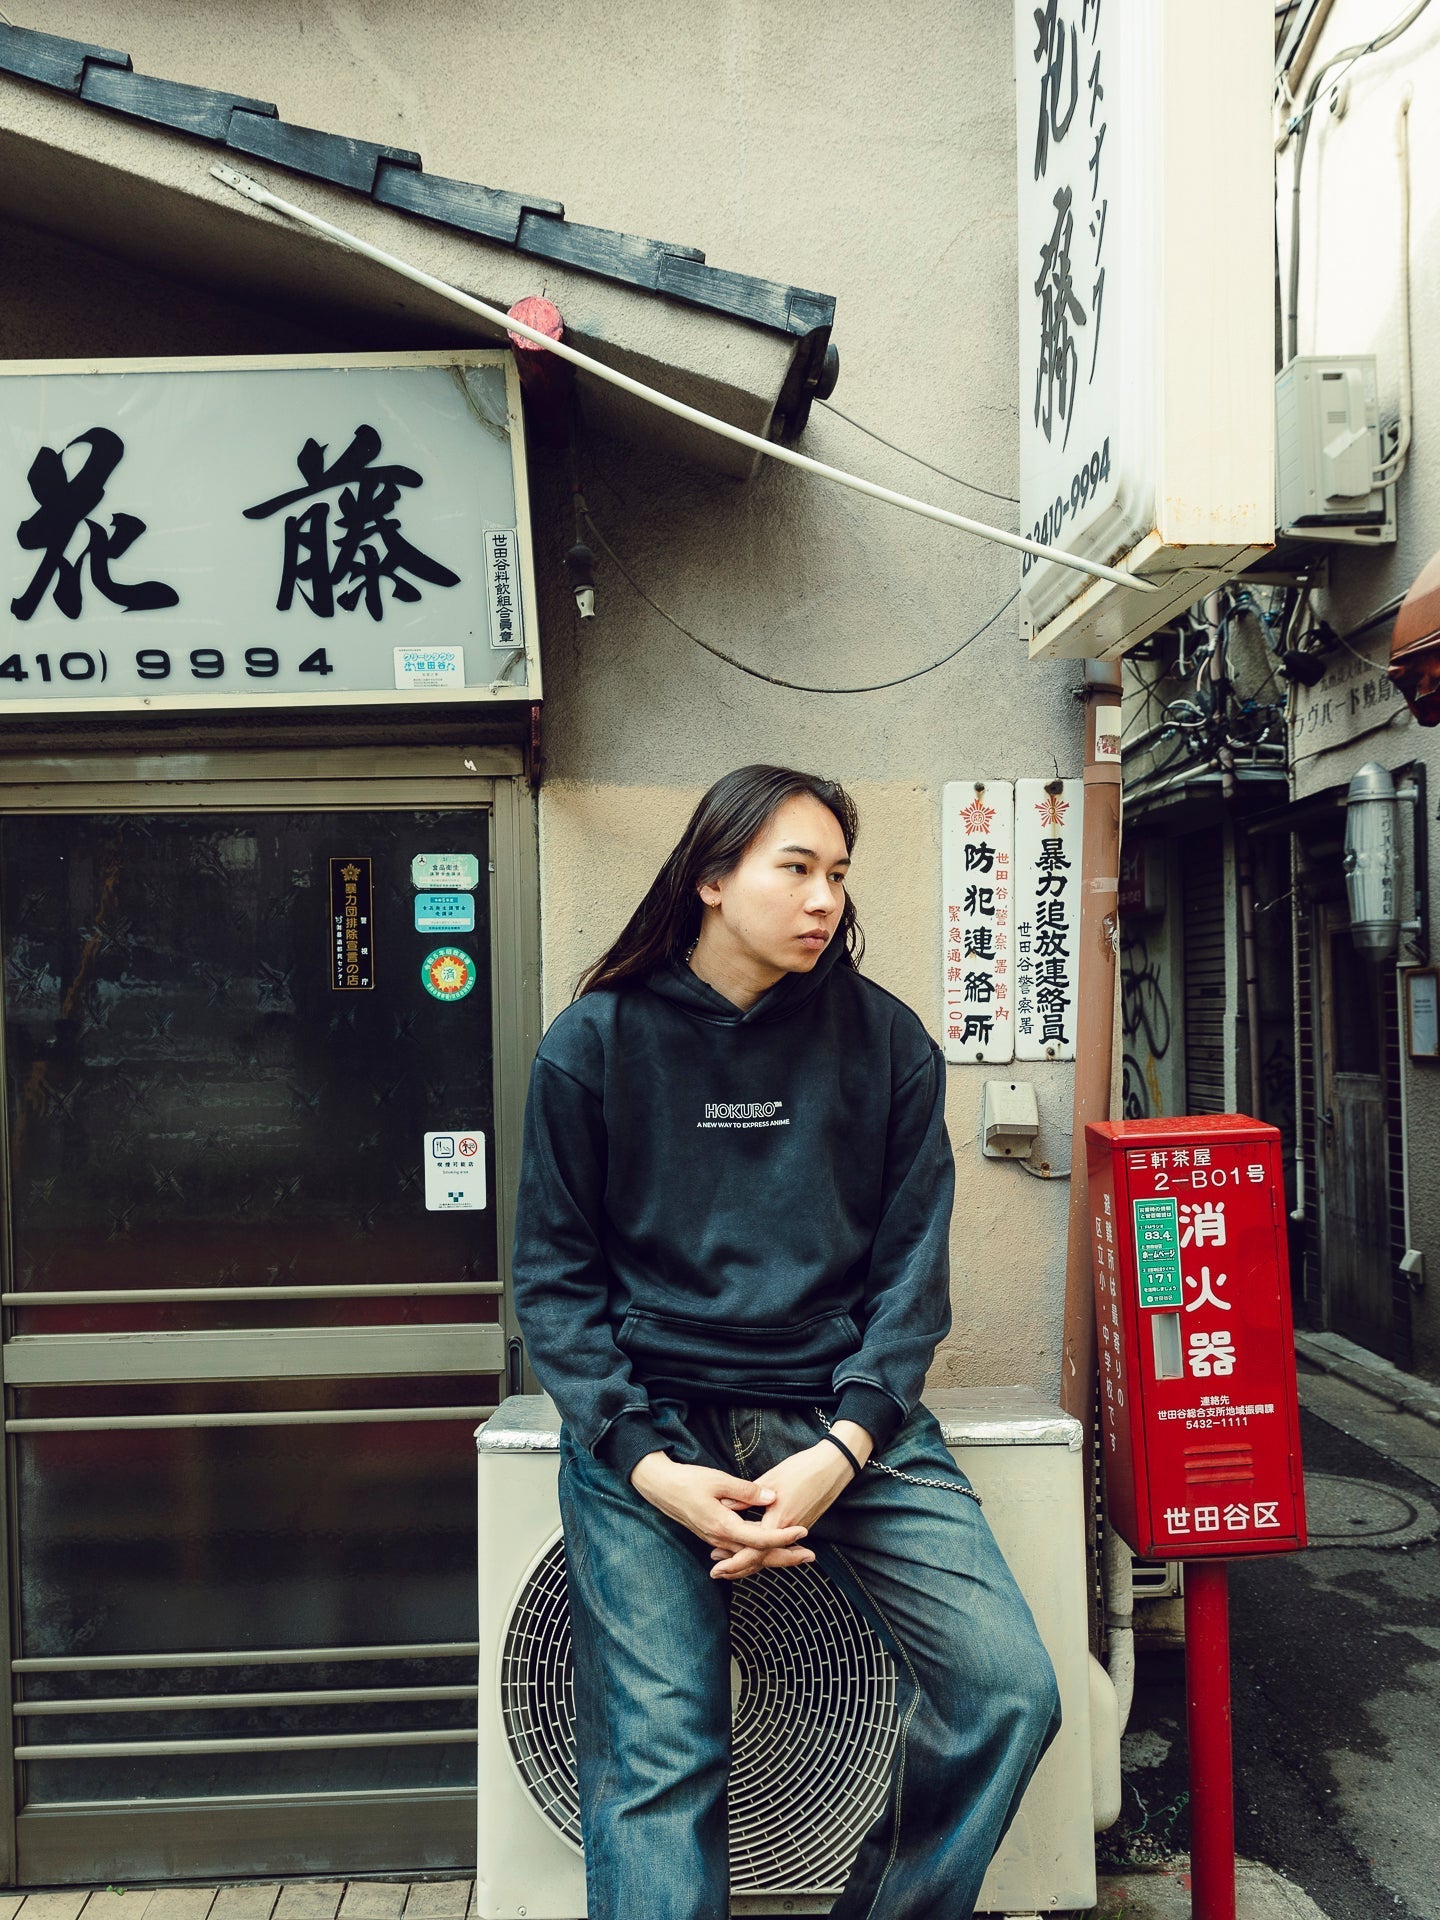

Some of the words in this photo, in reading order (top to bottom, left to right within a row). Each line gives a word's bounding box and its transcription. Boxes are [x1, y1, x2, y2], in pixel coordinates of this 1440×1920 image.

[492, 534, 514, 642] 世田谷料飲組合員章
[136, 647, 334, 680] 9994
[417, 661, 446, 670] 世田谷
[345, 883, 359, 986] 暴力団排除宣言の店
[960, 841, 997, 1046] 防犯連絡所
[994, 852, 1010, 1021] 世田谷警察署管内
[1033, 837, 1072, 1046] 暴力追放連絡員
[1017, 921, 1035, 1035] 世田谷警察署
[742, 1121, 769, 1129] EXPRESS
[770, 1118, 790, 1127] ANIME
[1130, 1148, 1211, 1170] 三軒茶屋
[1144, 1230, 1170, 1240] 83.4
[1142, 1250, 1175, 1259] ホームページ
[1148, 1273, 1172, 1284] 171
[1178, 1201, 1237, 1378] 消火器
[1157, 1403, 1275, 1420] 世田谷総合支所地域振興課
[1200, 1395, 1230, 1406] 連絡先
[1186, 1416, 1248, 1429] 5432-1111
[1163, 1501, 1281, 1535] 世田谷区
